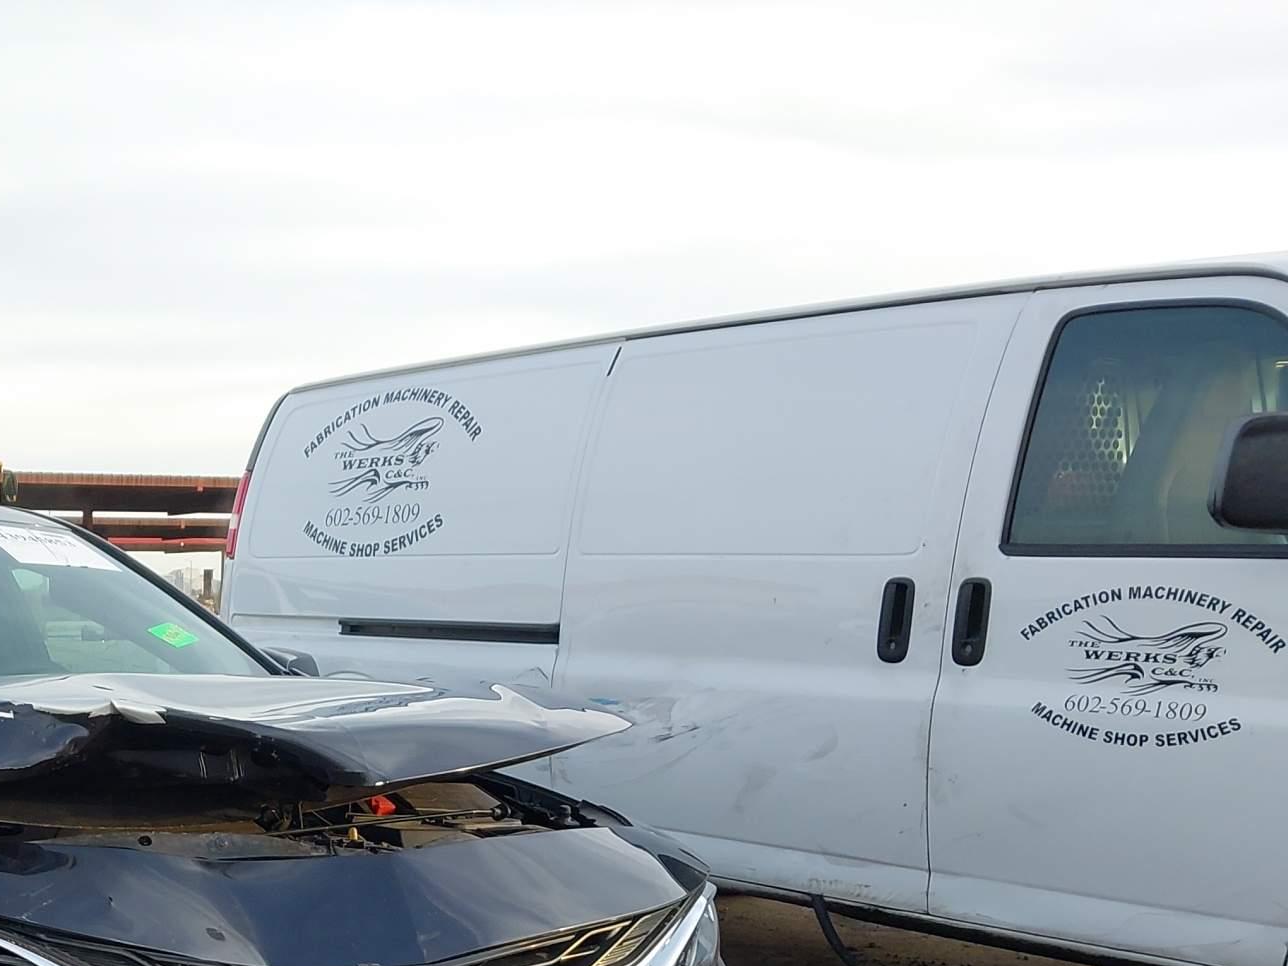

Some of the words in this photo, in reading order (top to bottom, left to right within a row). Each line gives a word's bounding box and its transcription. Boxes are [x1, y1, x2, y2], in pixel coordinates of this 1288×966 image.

[304, 395, 380, 458] FABRICATION
[383, 387, 452, 409] MACHINERY
[448, 400, 482, 441] REPAIR
[334, 451, 353, 459] THE
[343, 454, 405, 470] WERKS
[325, 503, 420, 527] 602-569-1809
[303, 520, 347, 555] MACHINE
[349, 543, 380, 557] SHOP
[383, 513, 444, 554] SERVICES
[1020, 588, 1122, 641] FABRICATION
[1128, 585, 1232, 615] MACHINERY
[1230, 608, 1287, 655] REPAIR
[1068, 640, 1101, 648] THE
[1084, 649, 1177, 664] WERKS
[1064, 694, 1207, 722] 602-569-1809
[1031, 702, 1099, 741] MACHINE
[1103, 731, 1149, 747] SHOP
[1155, 717, 1242, 748] SERVICES
